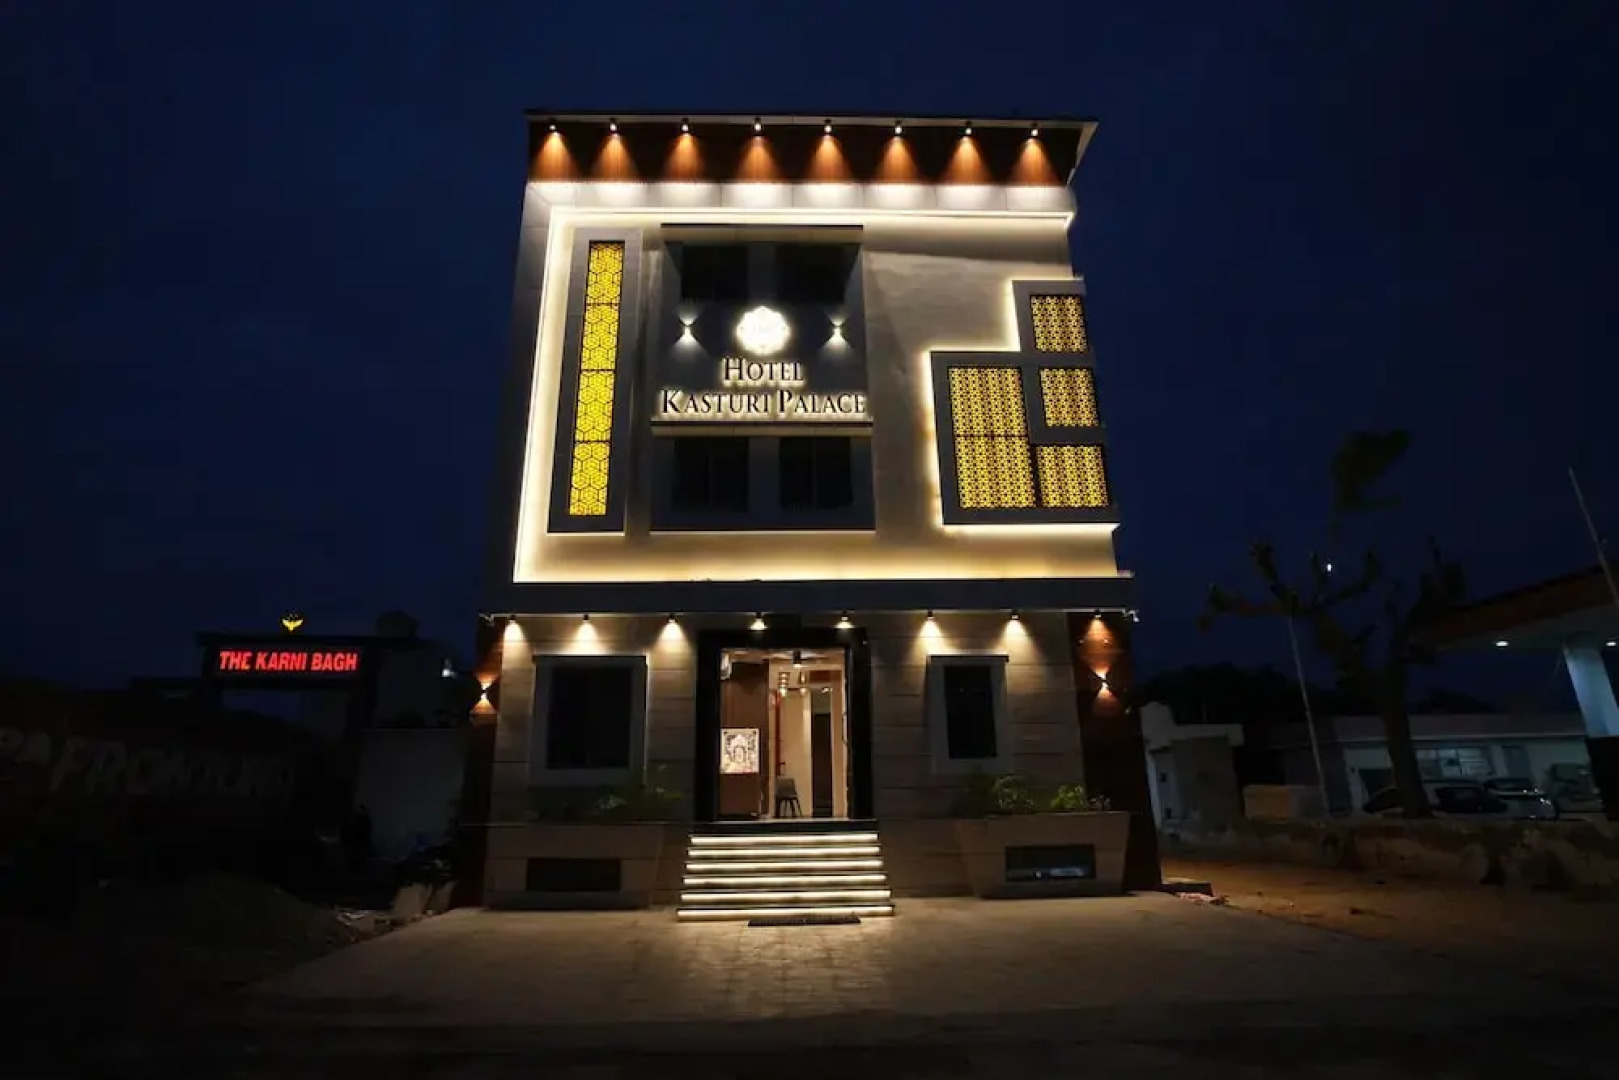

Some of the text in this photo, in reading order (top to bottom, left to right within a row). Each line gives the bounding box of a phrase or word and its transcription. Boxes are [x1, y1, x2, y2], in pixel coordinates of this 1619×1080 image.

[724, 357, 803, 381] HOTEL
[662, 389, 866, 413] KASTURI PALACE
[255, 652, 307, 670] KARNI
[311, 653, 358, 671] BAGH
